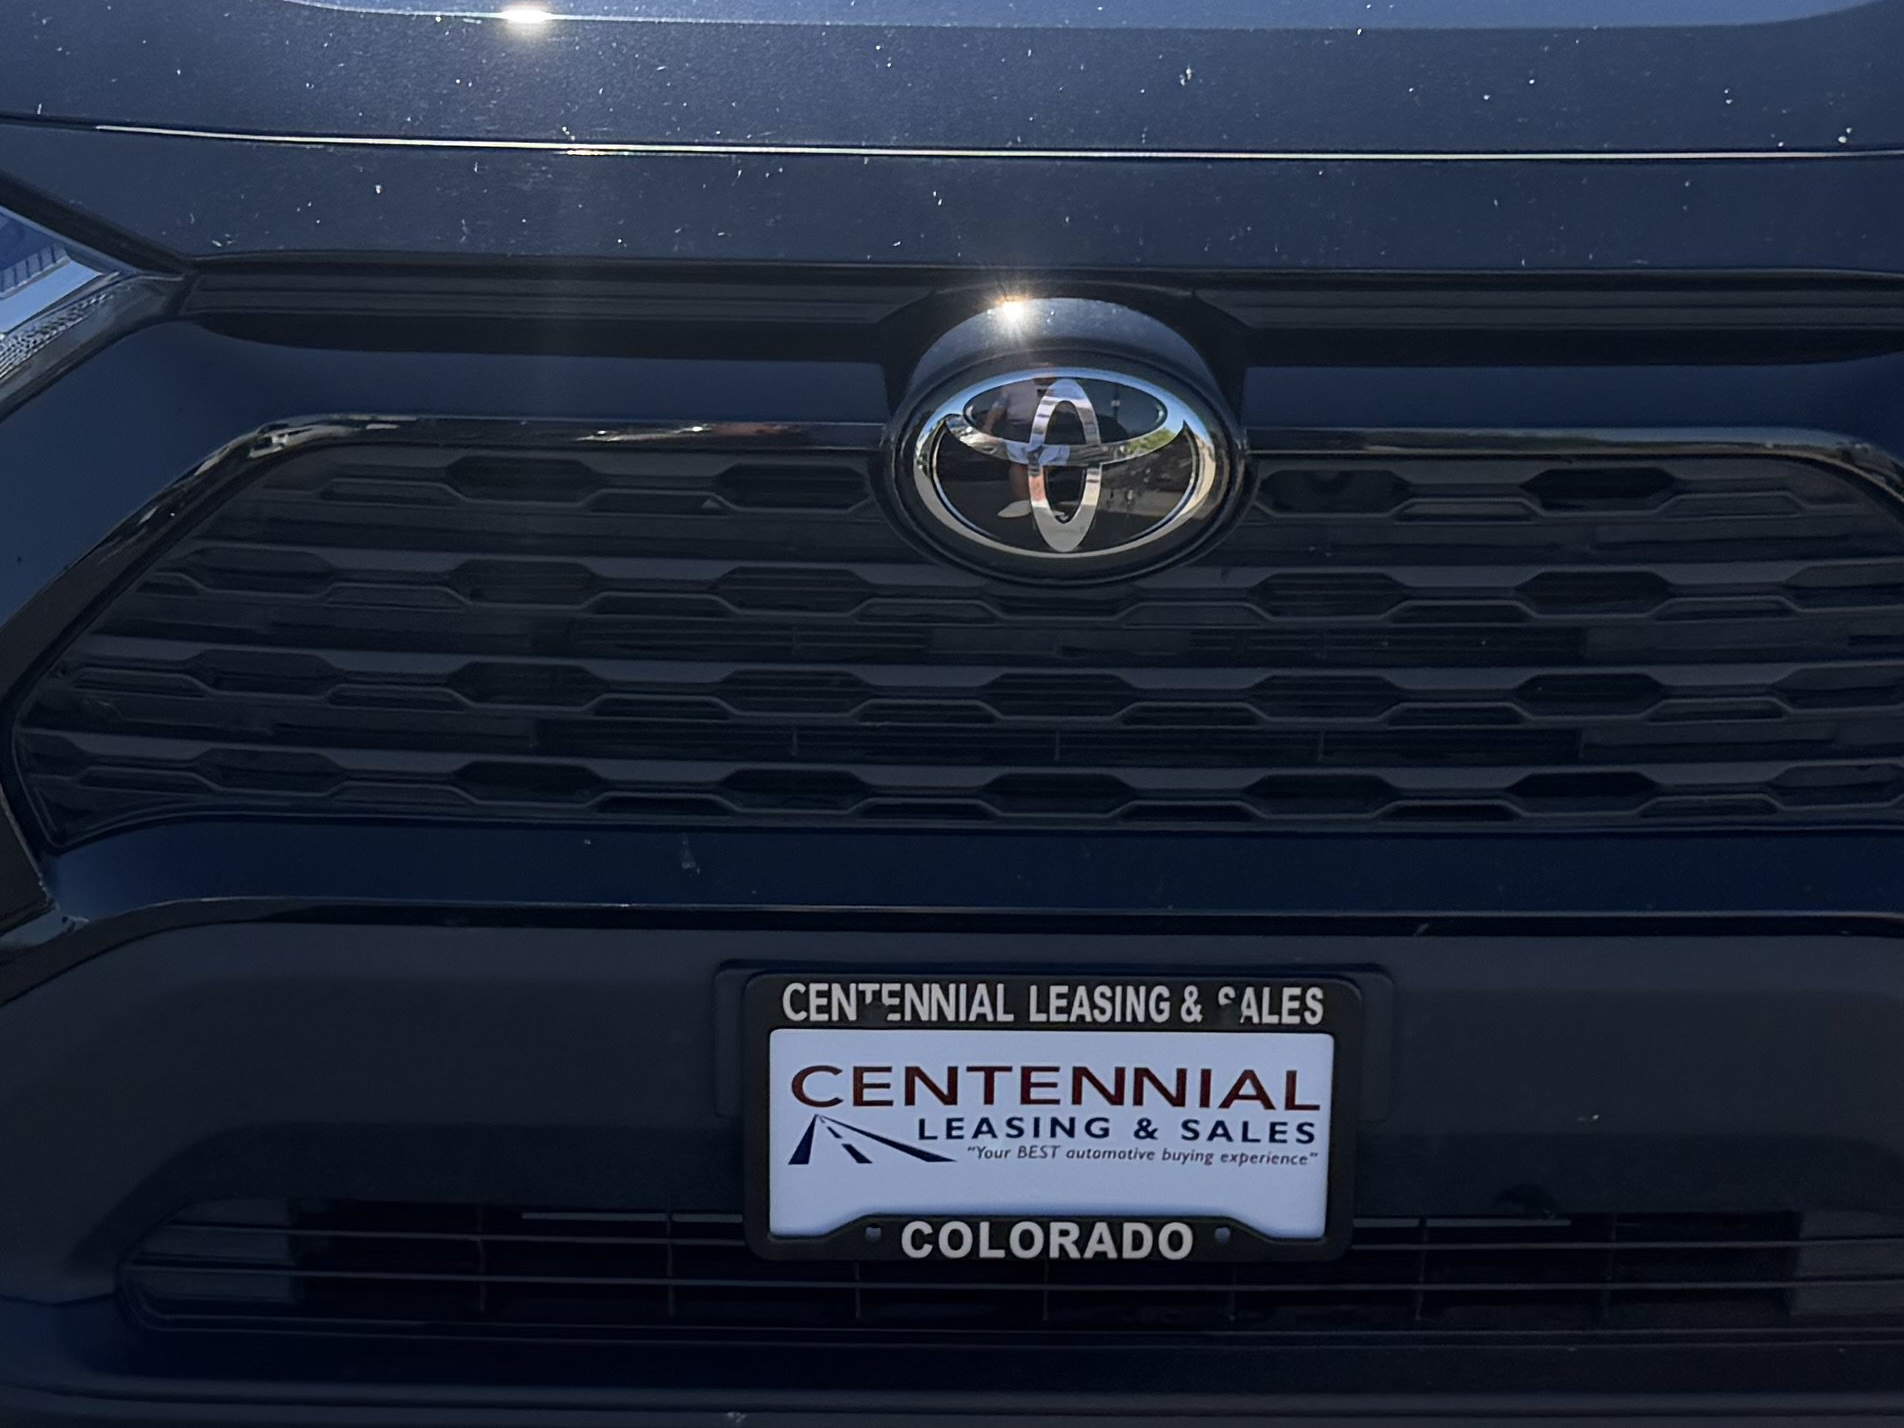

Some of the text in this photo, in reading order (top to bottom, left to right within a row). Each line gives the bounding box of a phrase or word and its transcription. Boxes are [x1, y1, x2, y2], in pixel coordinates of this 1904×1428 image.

[1028, 985, 1171, 1023] LEASING
[1180, 985, 1203, 1023] &
[791, 1065, 1321, 1111] CENTENNIAL
[918, 1117, 1315, 1144] LEASING & SALES
[1017, 1145, 1061, 1159] BEST
[1066, 1147, 1155, 1161] automotive
[1162, 1147, 1213, 1166] buying
[901, 1220, 1194, 1260] COLORADO
